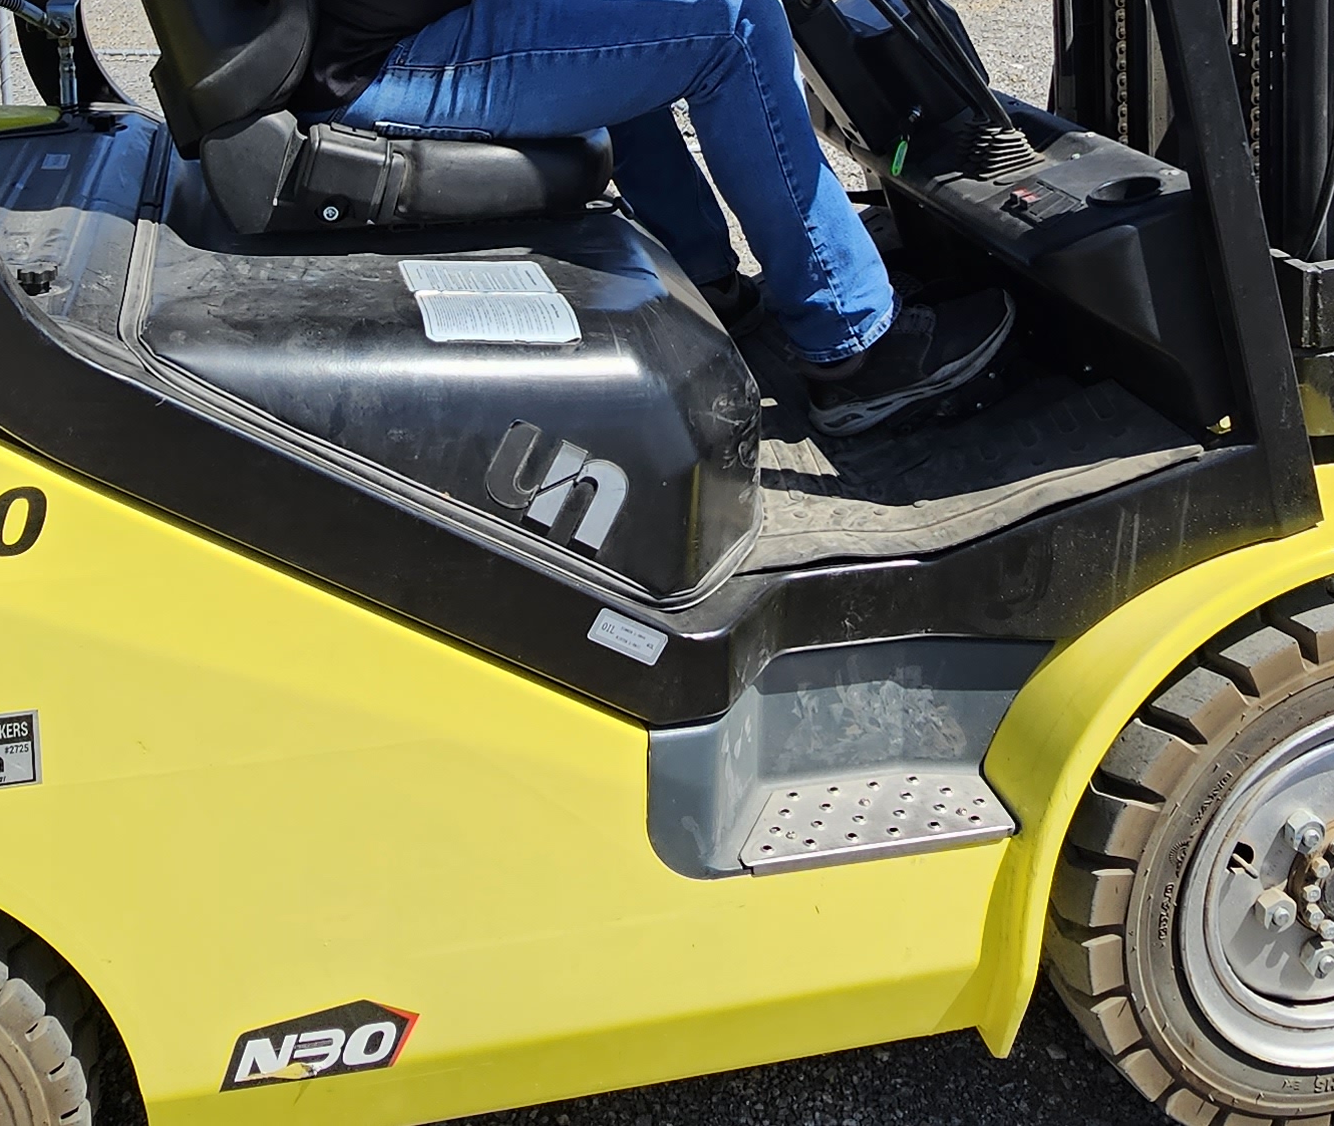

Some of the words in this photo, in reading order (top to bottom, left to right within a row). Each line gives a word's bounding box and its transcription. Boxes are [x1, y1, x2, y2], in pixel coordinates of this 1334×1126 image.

[601, 622, 616, 634] OIL
[4, 743, 29, 754] #2725
[234, 1021, 397, 1083] N30
